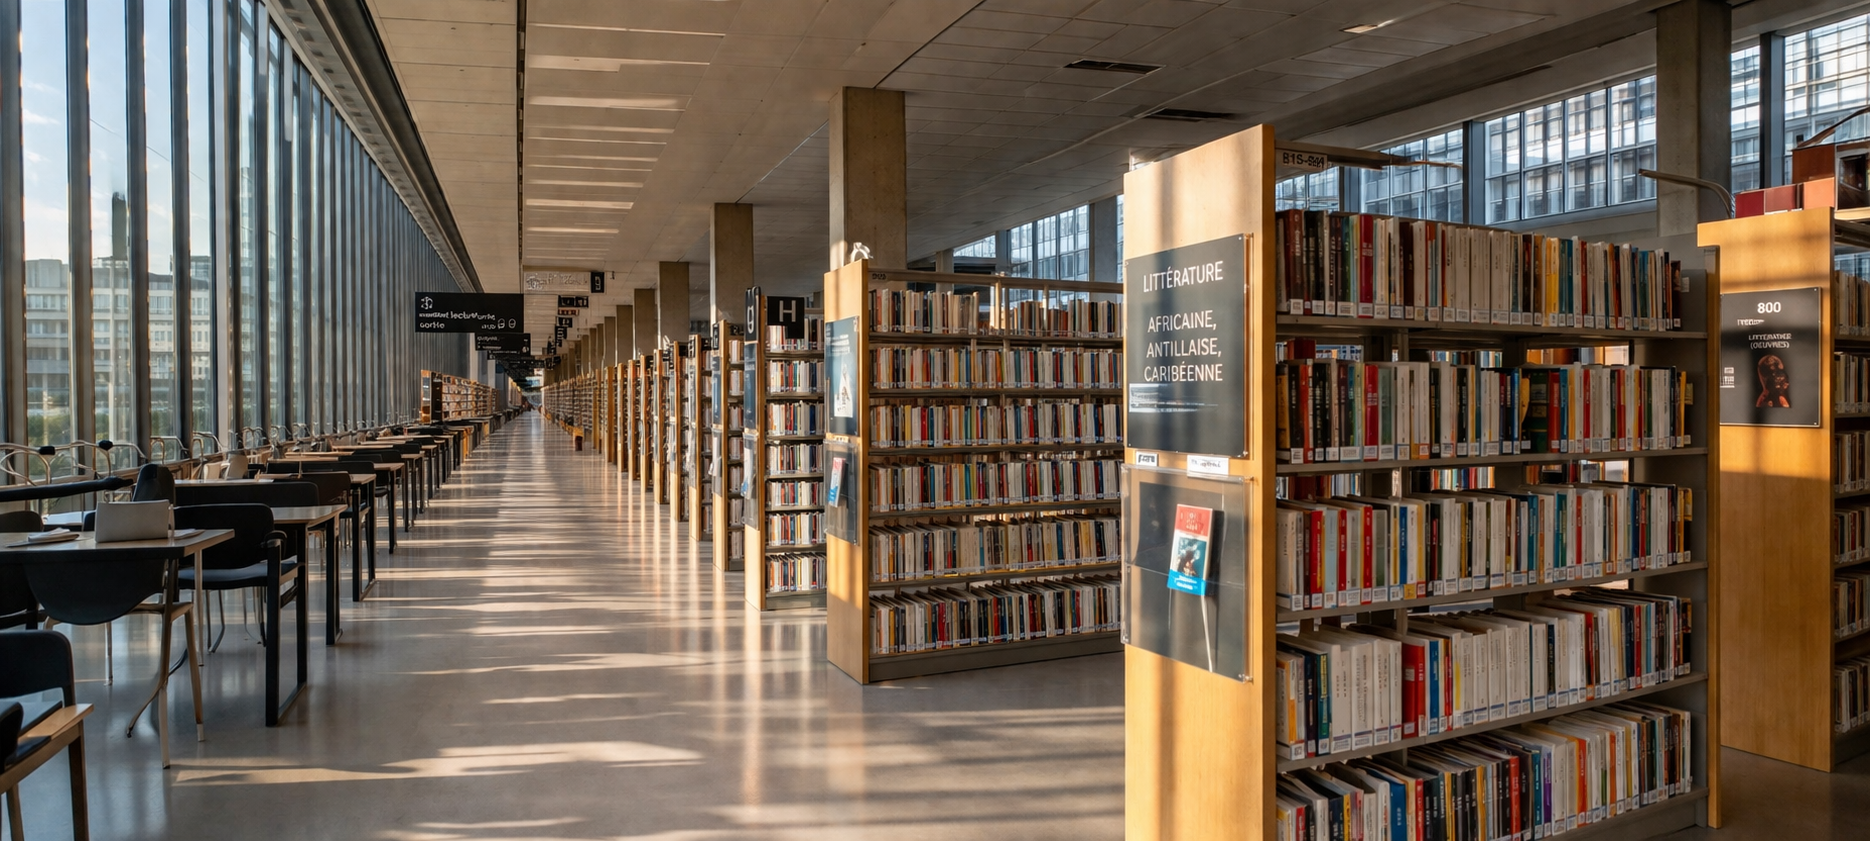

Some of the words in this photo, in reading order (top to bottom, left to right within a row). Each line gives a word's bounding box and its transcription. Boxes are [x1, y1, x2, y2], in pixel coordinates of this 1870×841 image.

[1143, 260, 1224, 292] LITTÉRATURE
[779, 300, 796, 322] H
[1757, 301, 1781, 314] 800
[1147, 310, 1217, 333] AFRICAINE,
[1146, 337, 1222, 358] ANTILLAISE,
[1143, 361, 1223, 382] CARIBÉENNE
